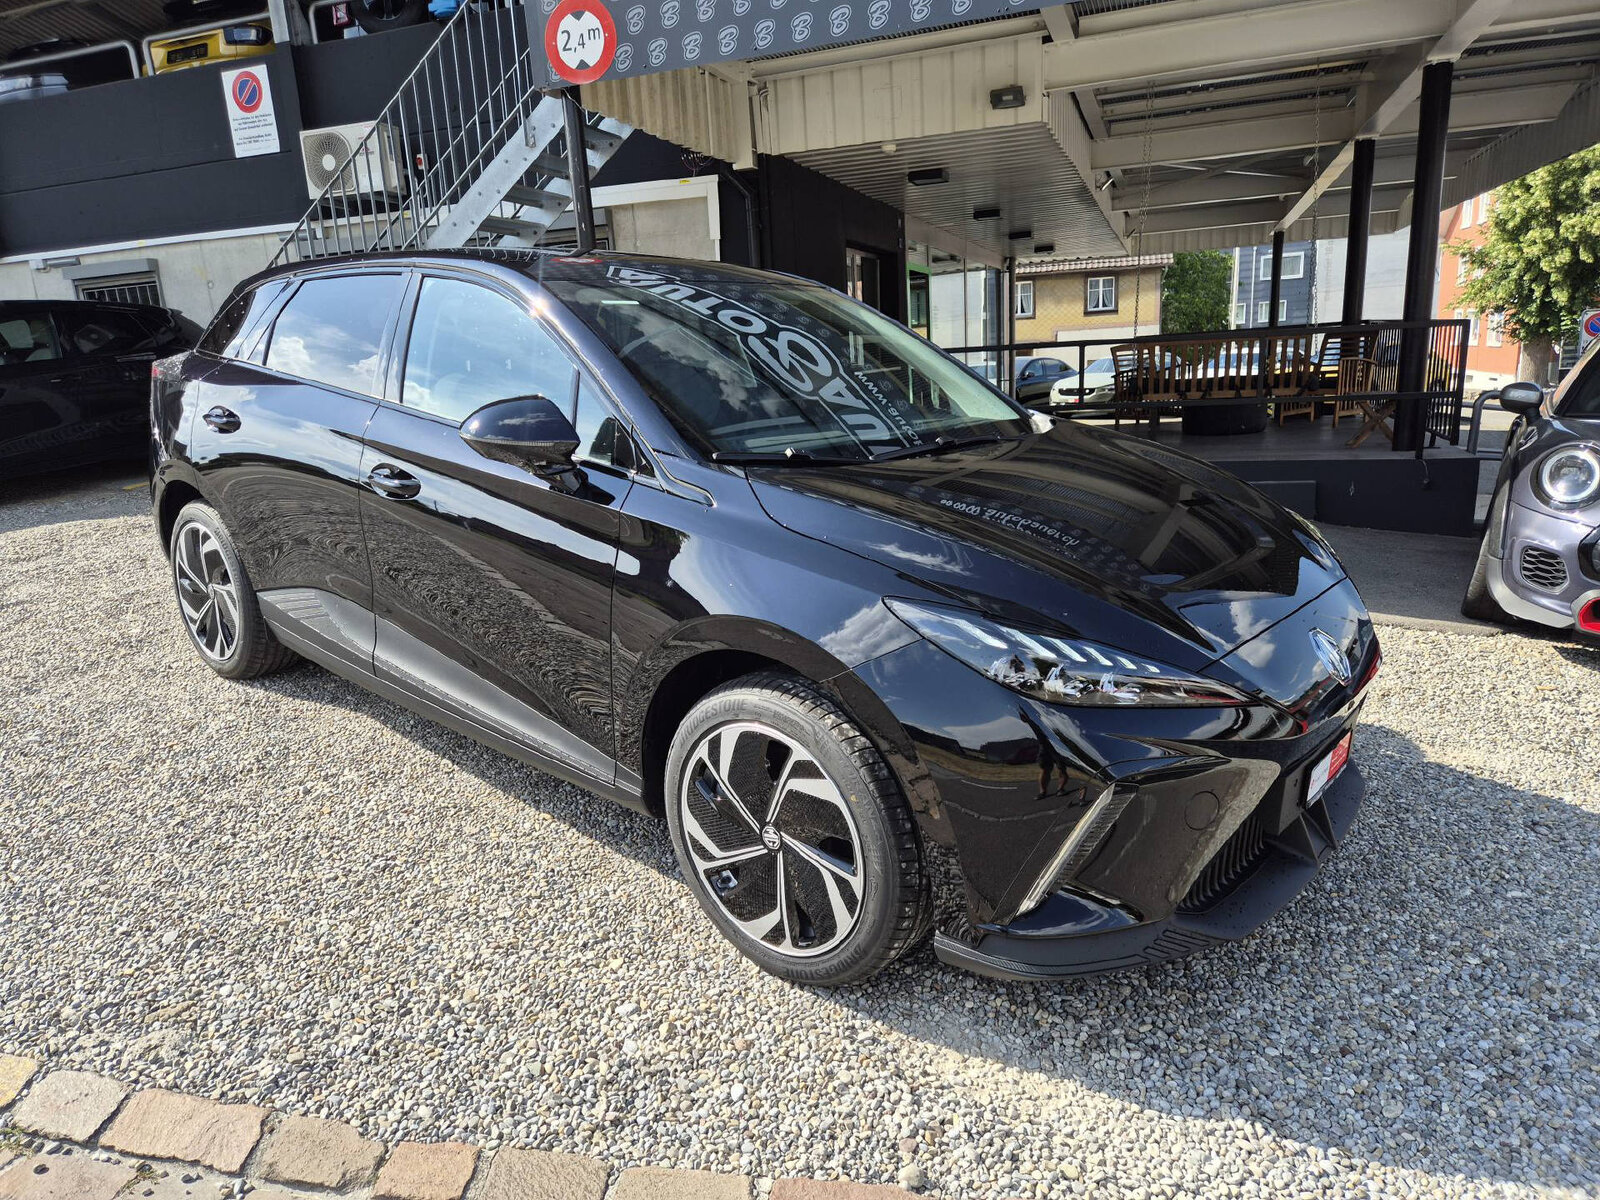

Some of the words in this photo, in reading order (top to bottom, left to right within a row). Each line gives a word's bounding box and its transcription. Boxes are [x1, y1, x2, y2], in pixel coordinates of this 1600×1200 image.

[615, 43, 633, 72] B
[648, 38, 667, 66] B
[682, 31, 702, 60] B
[718, 25, 739, 55] B
[754, 19, 775, 48] B
[791, 12, 813, 42] B
[829, 5, 852, 36] B
[626, 5, 646, 35] B
